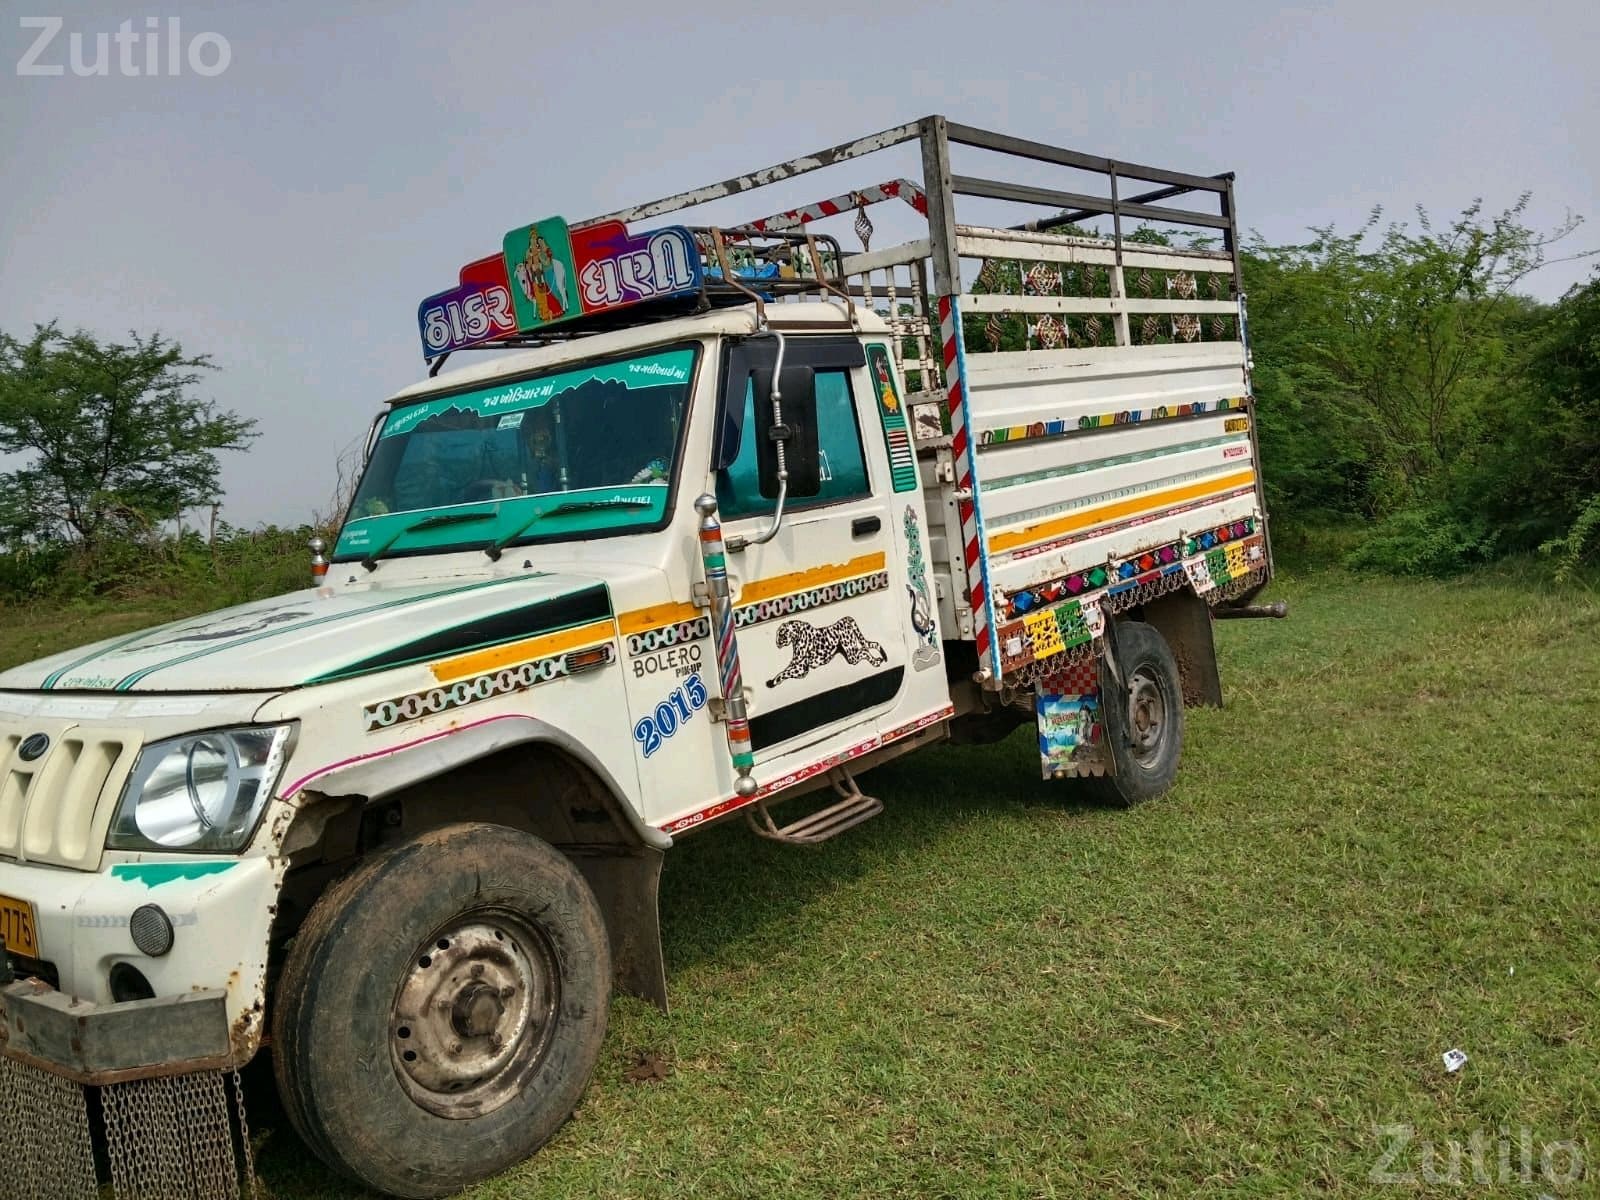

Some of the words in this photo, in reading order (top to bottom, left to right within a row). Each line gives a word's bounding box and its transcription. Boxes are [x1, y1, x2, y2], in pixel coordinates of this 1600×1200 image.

[633, 643, 702, 679] BOLERO
[634, 672, 707, 758] 2015
[0, 907, 31, 946] 775
